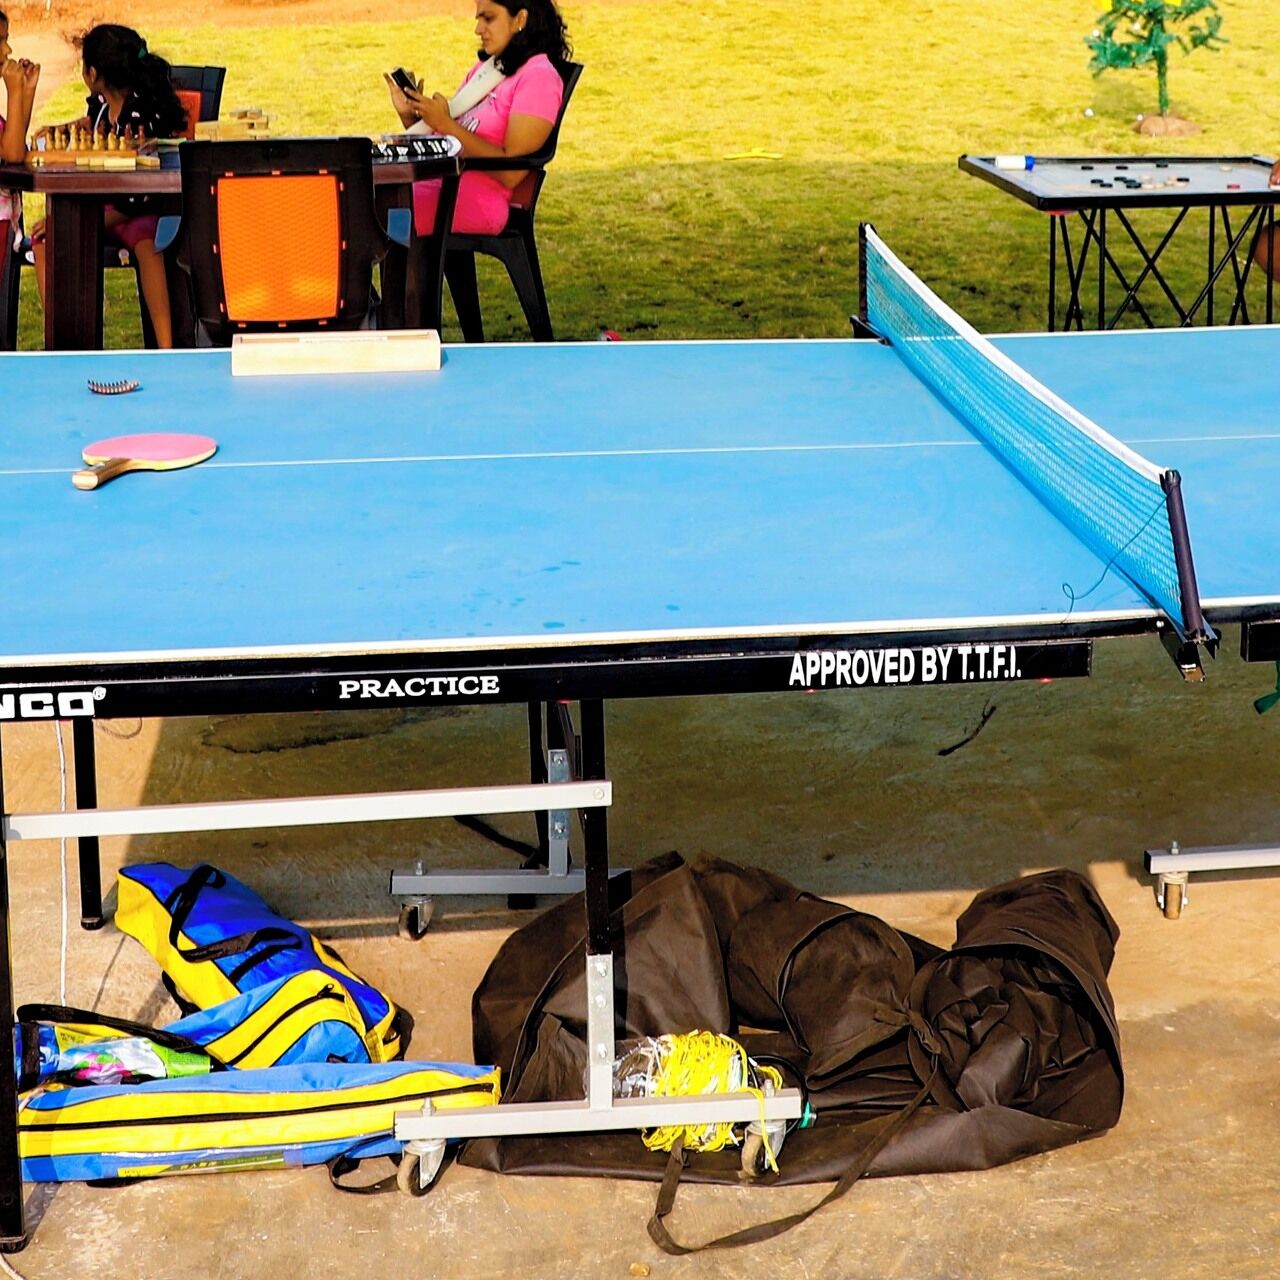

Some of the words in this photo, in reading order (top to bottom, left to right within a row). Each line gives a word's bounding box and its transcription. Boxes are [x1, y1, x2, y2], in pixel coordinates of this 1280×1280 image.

[789, 649, 915, 686] APPROVED
[921, 647, 952, 682] BY
[958, 645, 1021, 680] T.T.F.I.
[339, 676, 500, 699] PRACTICE
